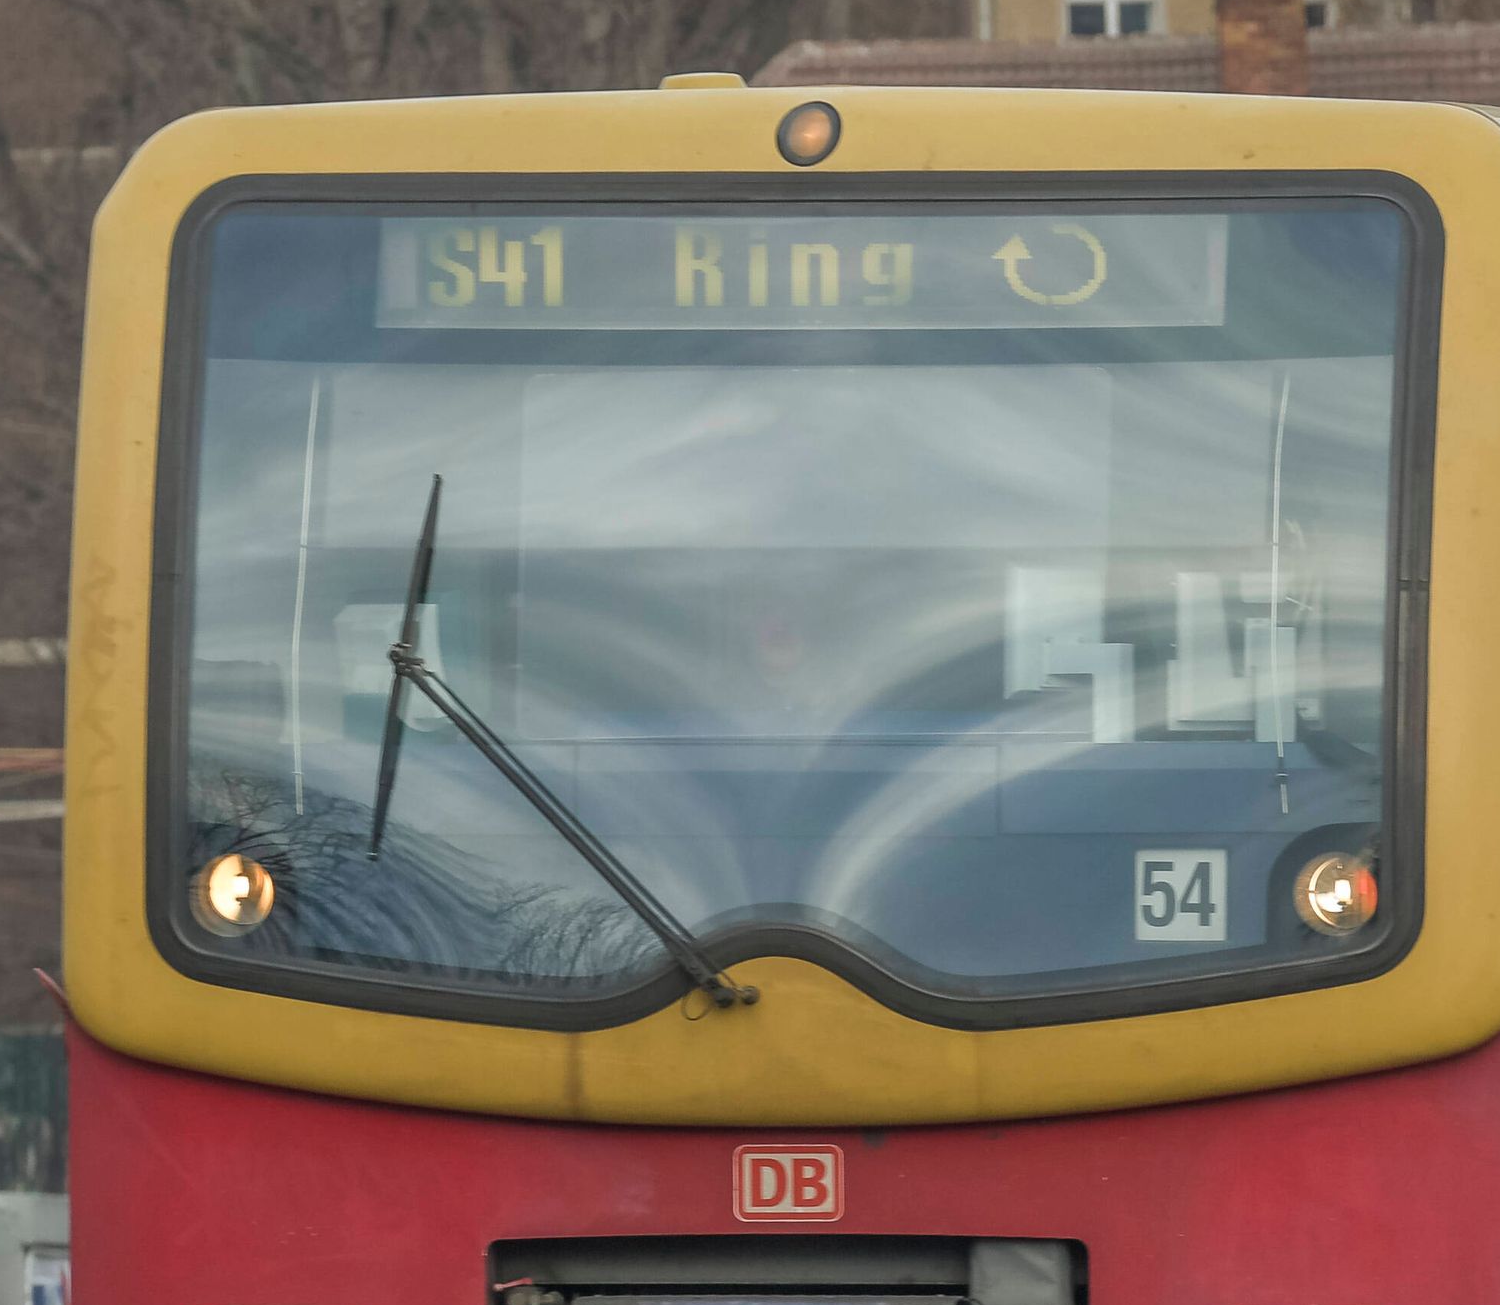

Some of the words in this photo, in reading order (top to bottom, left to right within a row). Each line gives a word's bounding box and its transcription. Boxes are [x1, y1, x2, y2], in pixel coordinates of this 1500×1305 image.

[426, 225, 566, 309] S41
[674, 225, 916, 307] Ring
[1141, 861, 1216, 927] 54
[751, 1158, 829, 1208] DB
